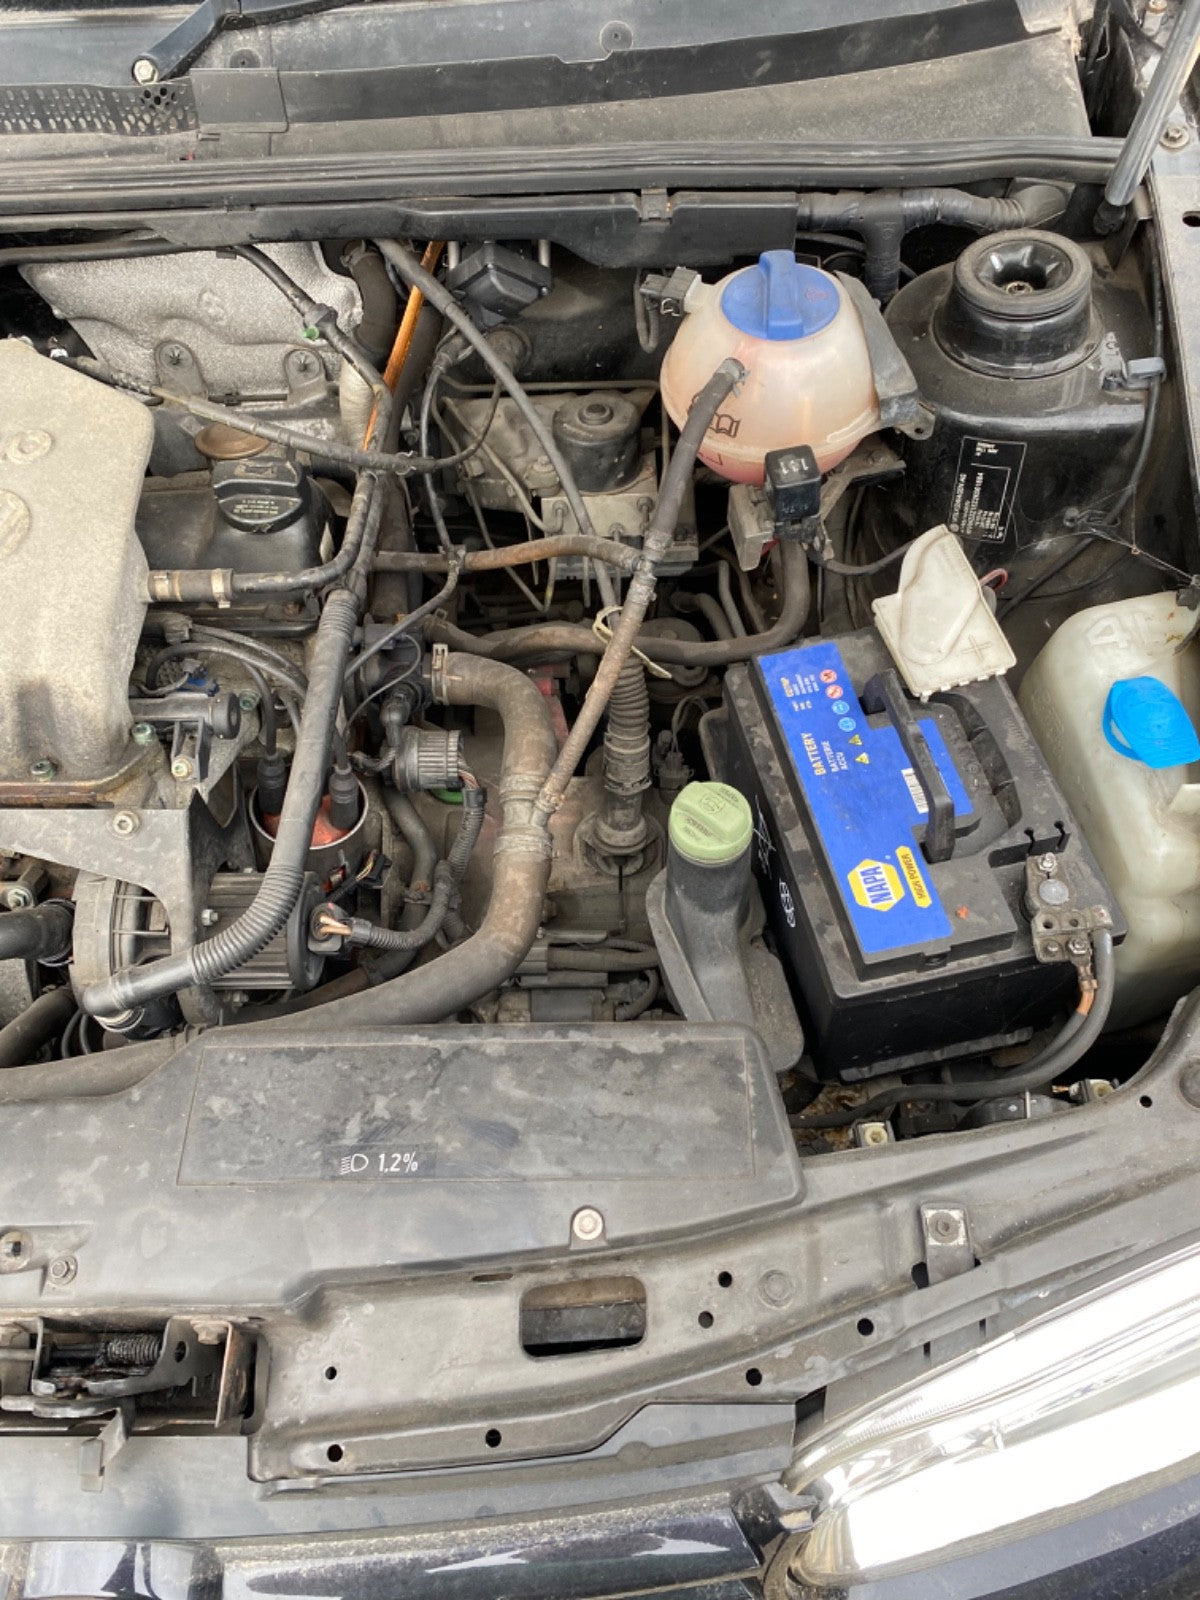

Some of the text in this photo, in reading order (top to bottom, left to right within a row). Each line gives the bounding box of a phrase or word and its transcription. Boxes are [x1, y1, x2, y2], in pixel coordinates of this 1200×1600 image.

[801, 733, 827, 776] BATTERY
[821, 740, 840, 772] BATTERIE
[901, 853, 919, 881] POWER
[860, 866, 894, 904] NAPA
